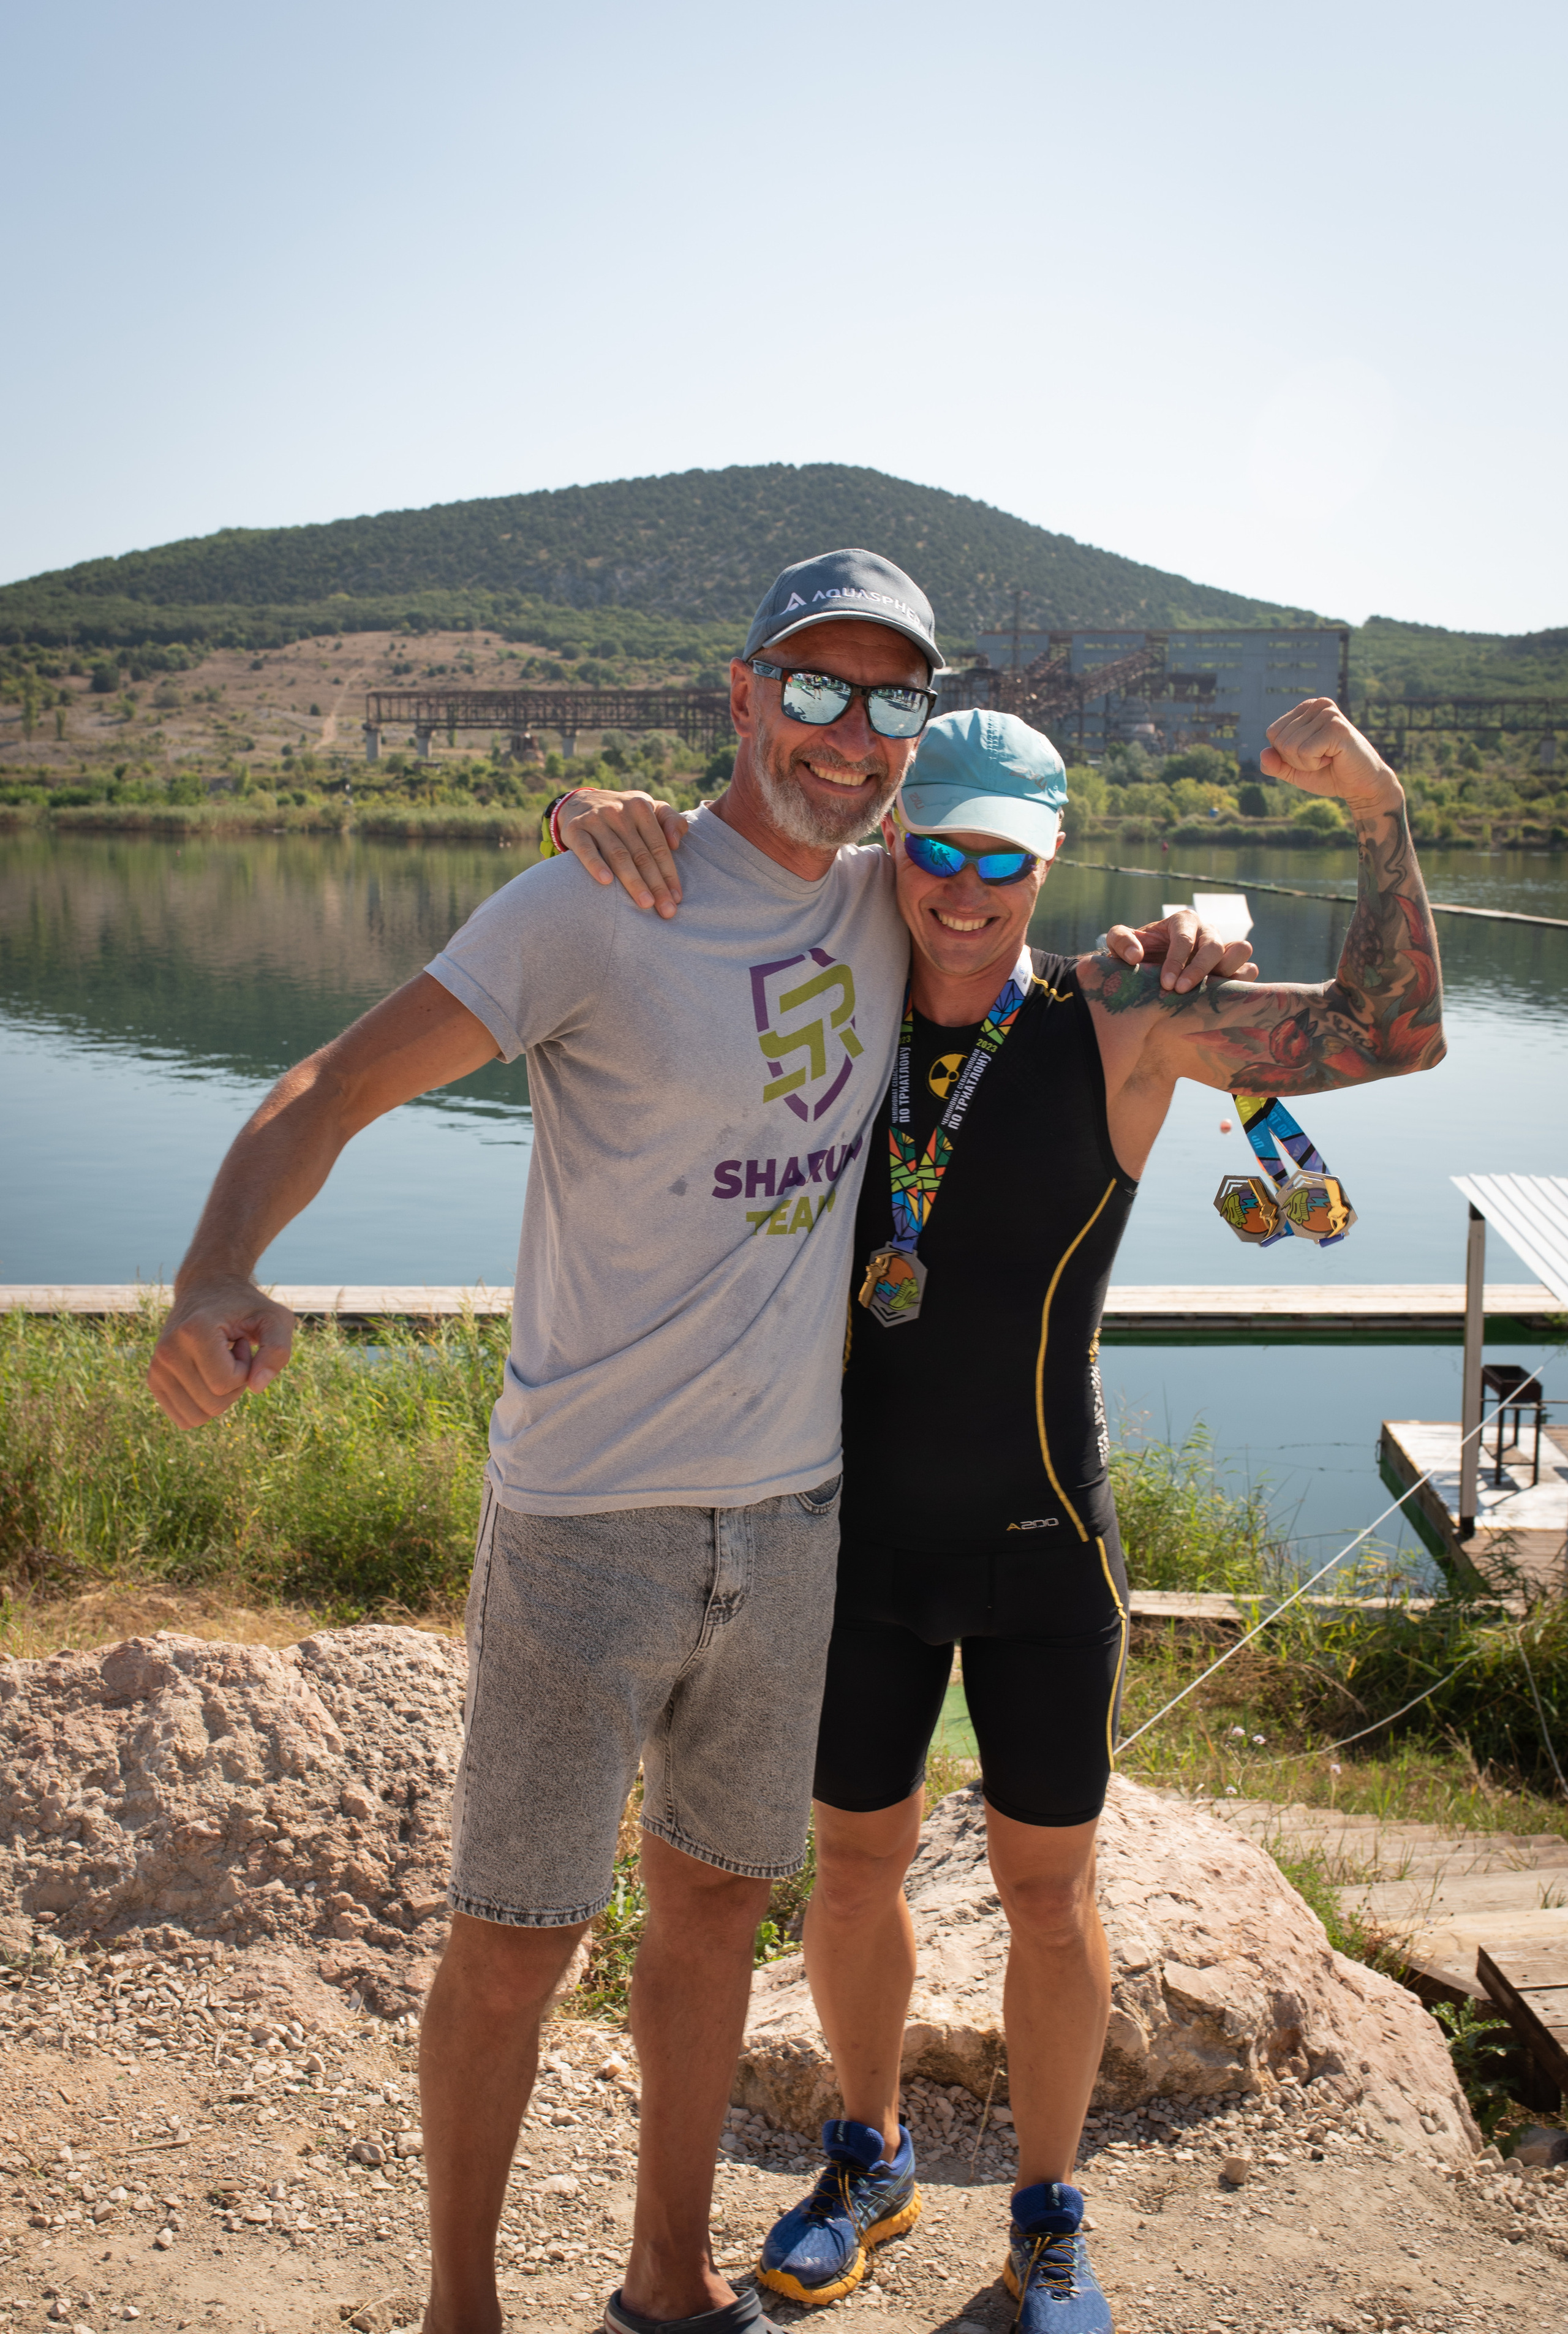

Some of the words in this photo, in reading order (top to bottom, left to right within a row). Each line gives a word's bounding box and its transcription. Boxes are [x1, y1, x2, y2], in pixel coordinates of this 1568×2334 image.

[812, 587, 924, 627] AQUASPHE
[899, 1035, 911, 1044] 23
[976, 1038, 998, 1053] 2023
[899, 1047, 911, 1106] ТРИАТЛОНУ
[955, 1051, 992, 1112] ТРИАТЛОНУ
[941, 1090, 962, 1125] ЧЕМПИОНАТ
[957, 1048, 981, 1090] СЕВАСТОПОЛЯ
[899, 1108, 911, 1123] ПО
[948, 1113, 963, 1130] ПО
[1006, 1517, 1060, 1531] A200
